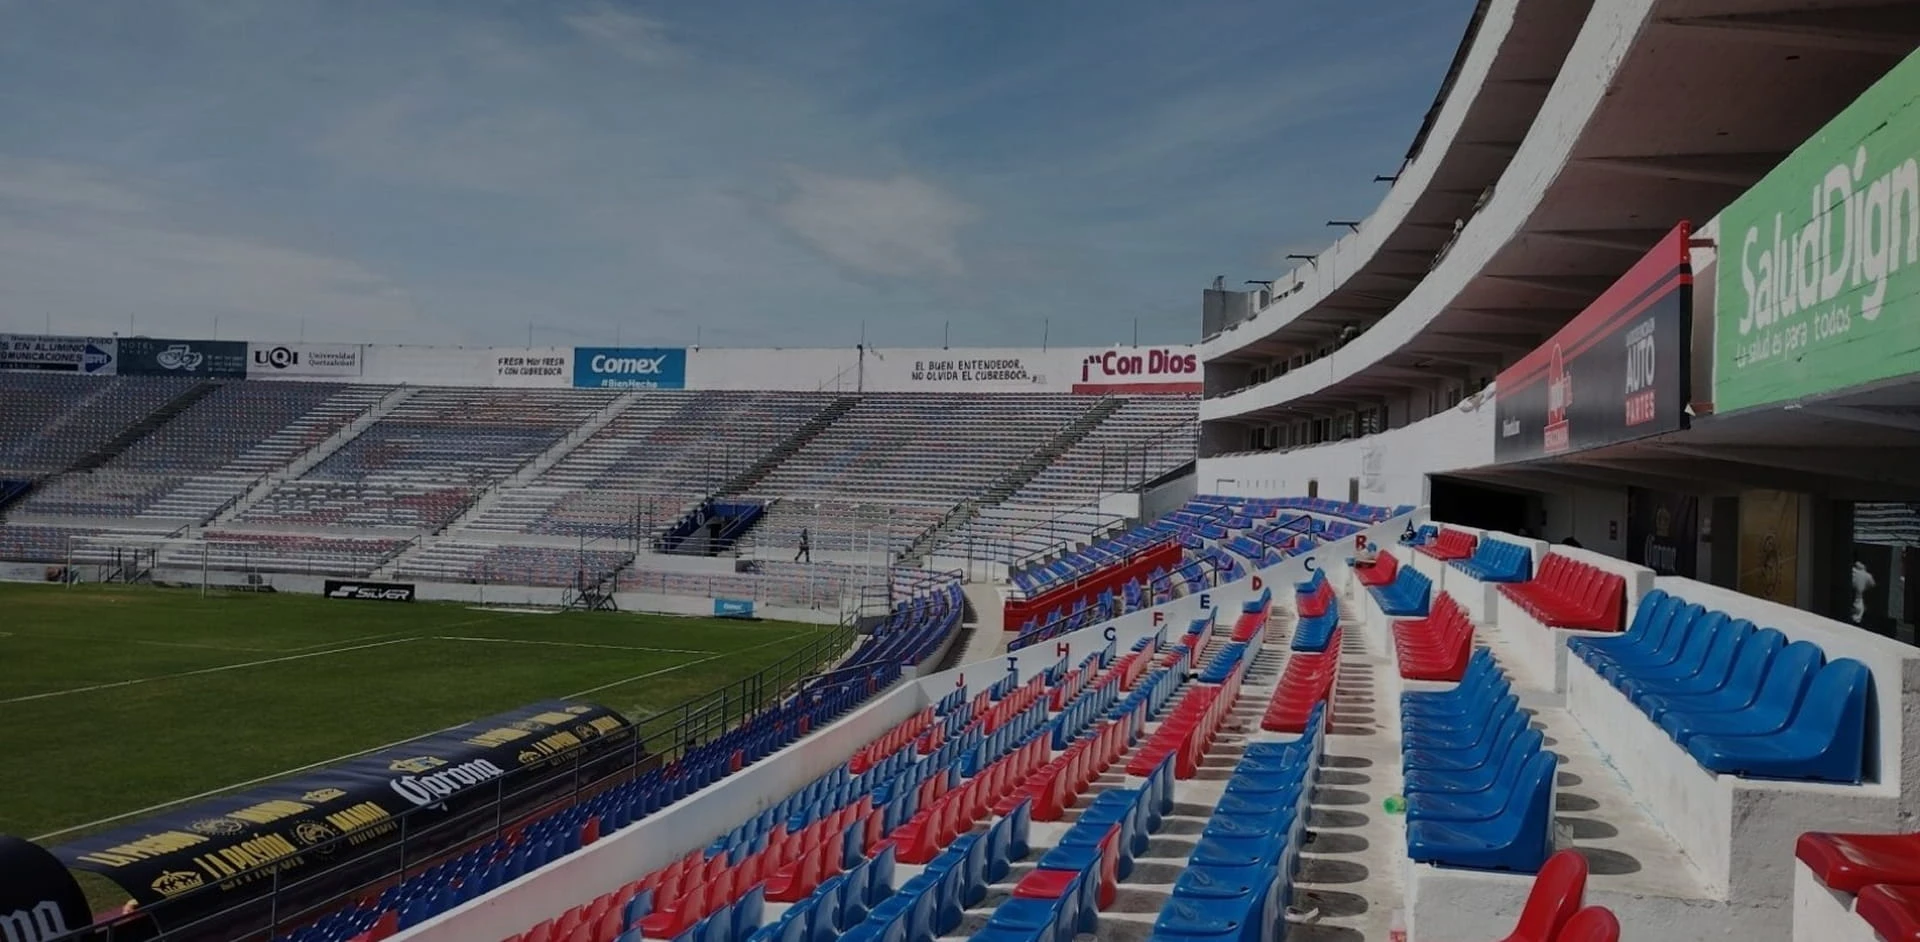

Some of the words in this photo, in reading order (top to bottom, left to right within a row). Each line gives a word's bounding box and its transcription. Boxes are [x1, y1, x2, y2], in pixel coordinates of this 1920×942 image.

[1785, 321, 1808, 360] para
[1815, 303, 1851, 341] todos
[14, 342, 30, 351] EN
[35, 343, 85, 353] ALUMINIO
[308, 352, 356, 361] Universidad
[591, 354, 667, 374] Comex
[1148, 349, 1197, 374] Dios
[1625, 334, 1656, 394] AUTO
[504, 366, 519, 375] CON
[915, 361, 925, 370] EL
[929, 361, 954, 370] BUEN
[601, 378, 658, 388] #BienHecho
[911, 371, 924, 380] NO
[926, 371, 958, 380] OLVIDA
[962, 371, 973, 381] EL
[1304, 556, 1316, 572] C
[1252, 575, 1264, 591] D
[355, 587, 411, 600] SILVER
[1200, 593, 1211, 609] E
[1152, 611, 1164, 627] F
[1057, 642, 1070, 658] H
[1007, 656, 1018, 672] I
[956, 672, 965, 688] J
[389, 758, 504, 813] Corona
